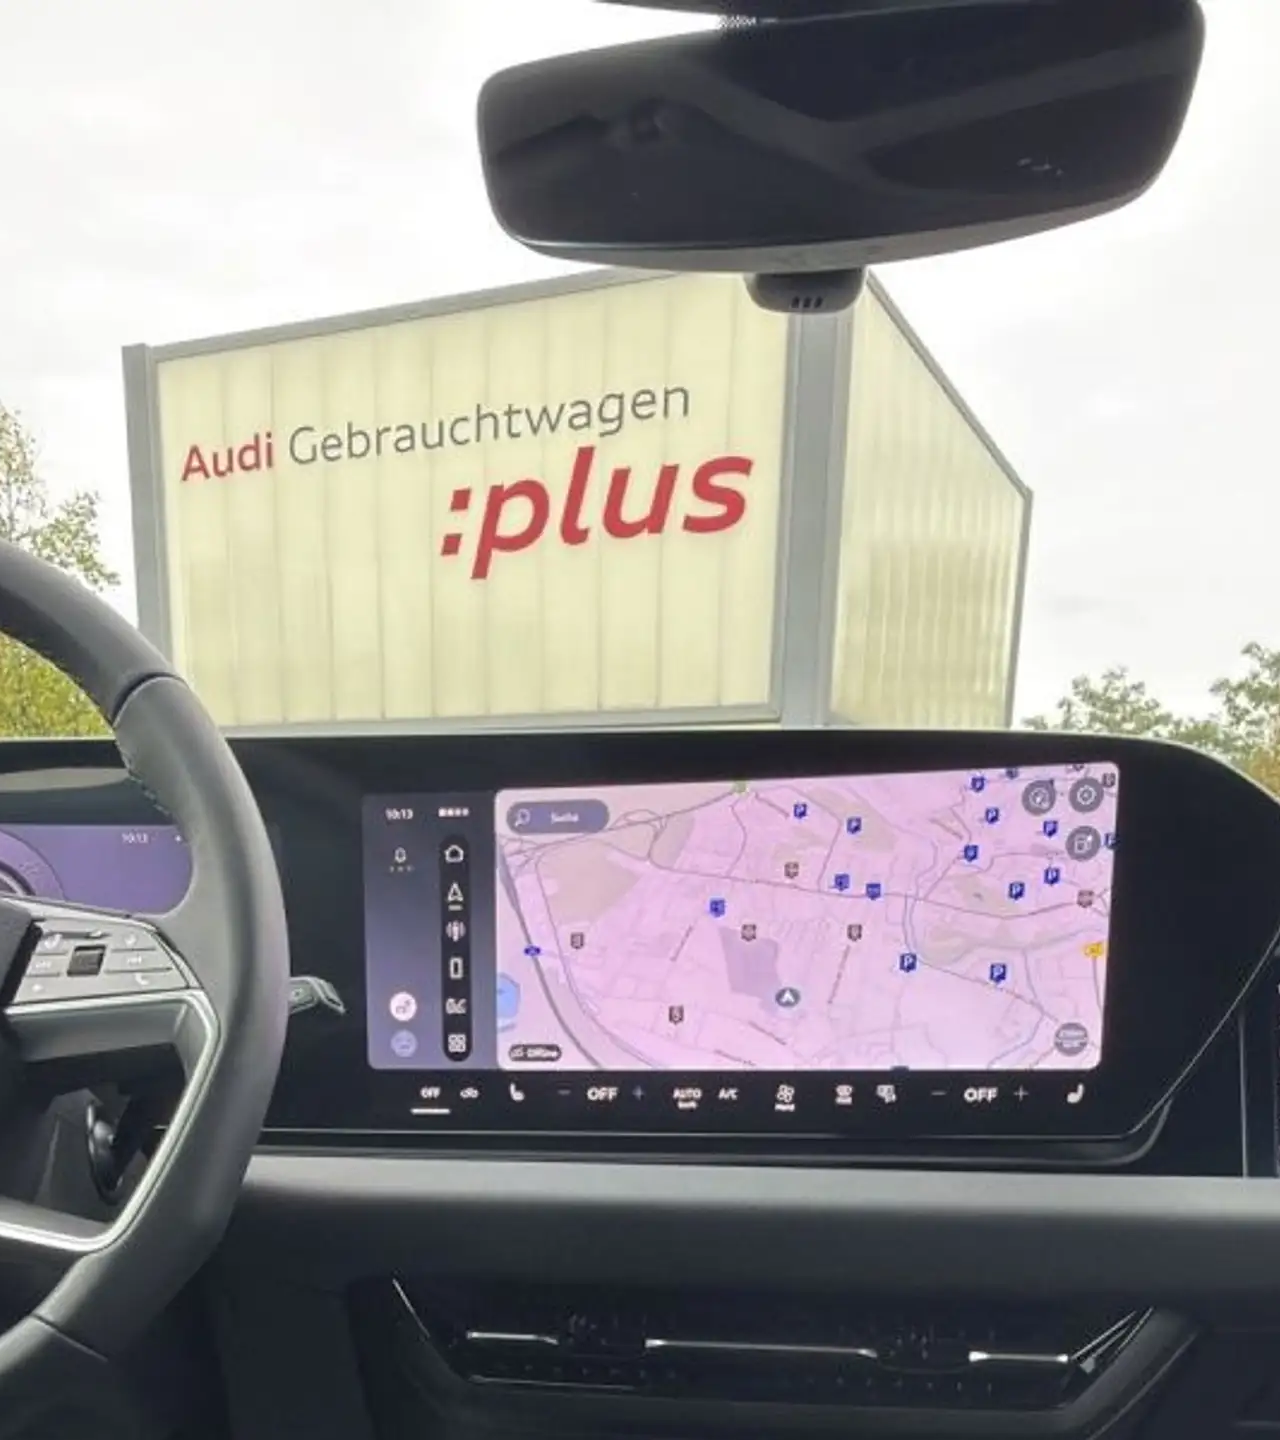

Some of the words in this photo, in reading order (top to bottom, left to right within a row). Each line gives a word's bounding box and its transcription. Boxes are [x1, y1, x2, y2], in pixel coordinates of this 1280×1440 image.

[181, 432, 274, 481] Audi
[288, 385, 689, 466] Gebrauchtwagen
[440, 445, 754, 580] :plus
[586, 1086, 618, 1102] OFF
[672, 1087, 703, 1100] AUTO
[963, 1087, 999, 1102] OFF
